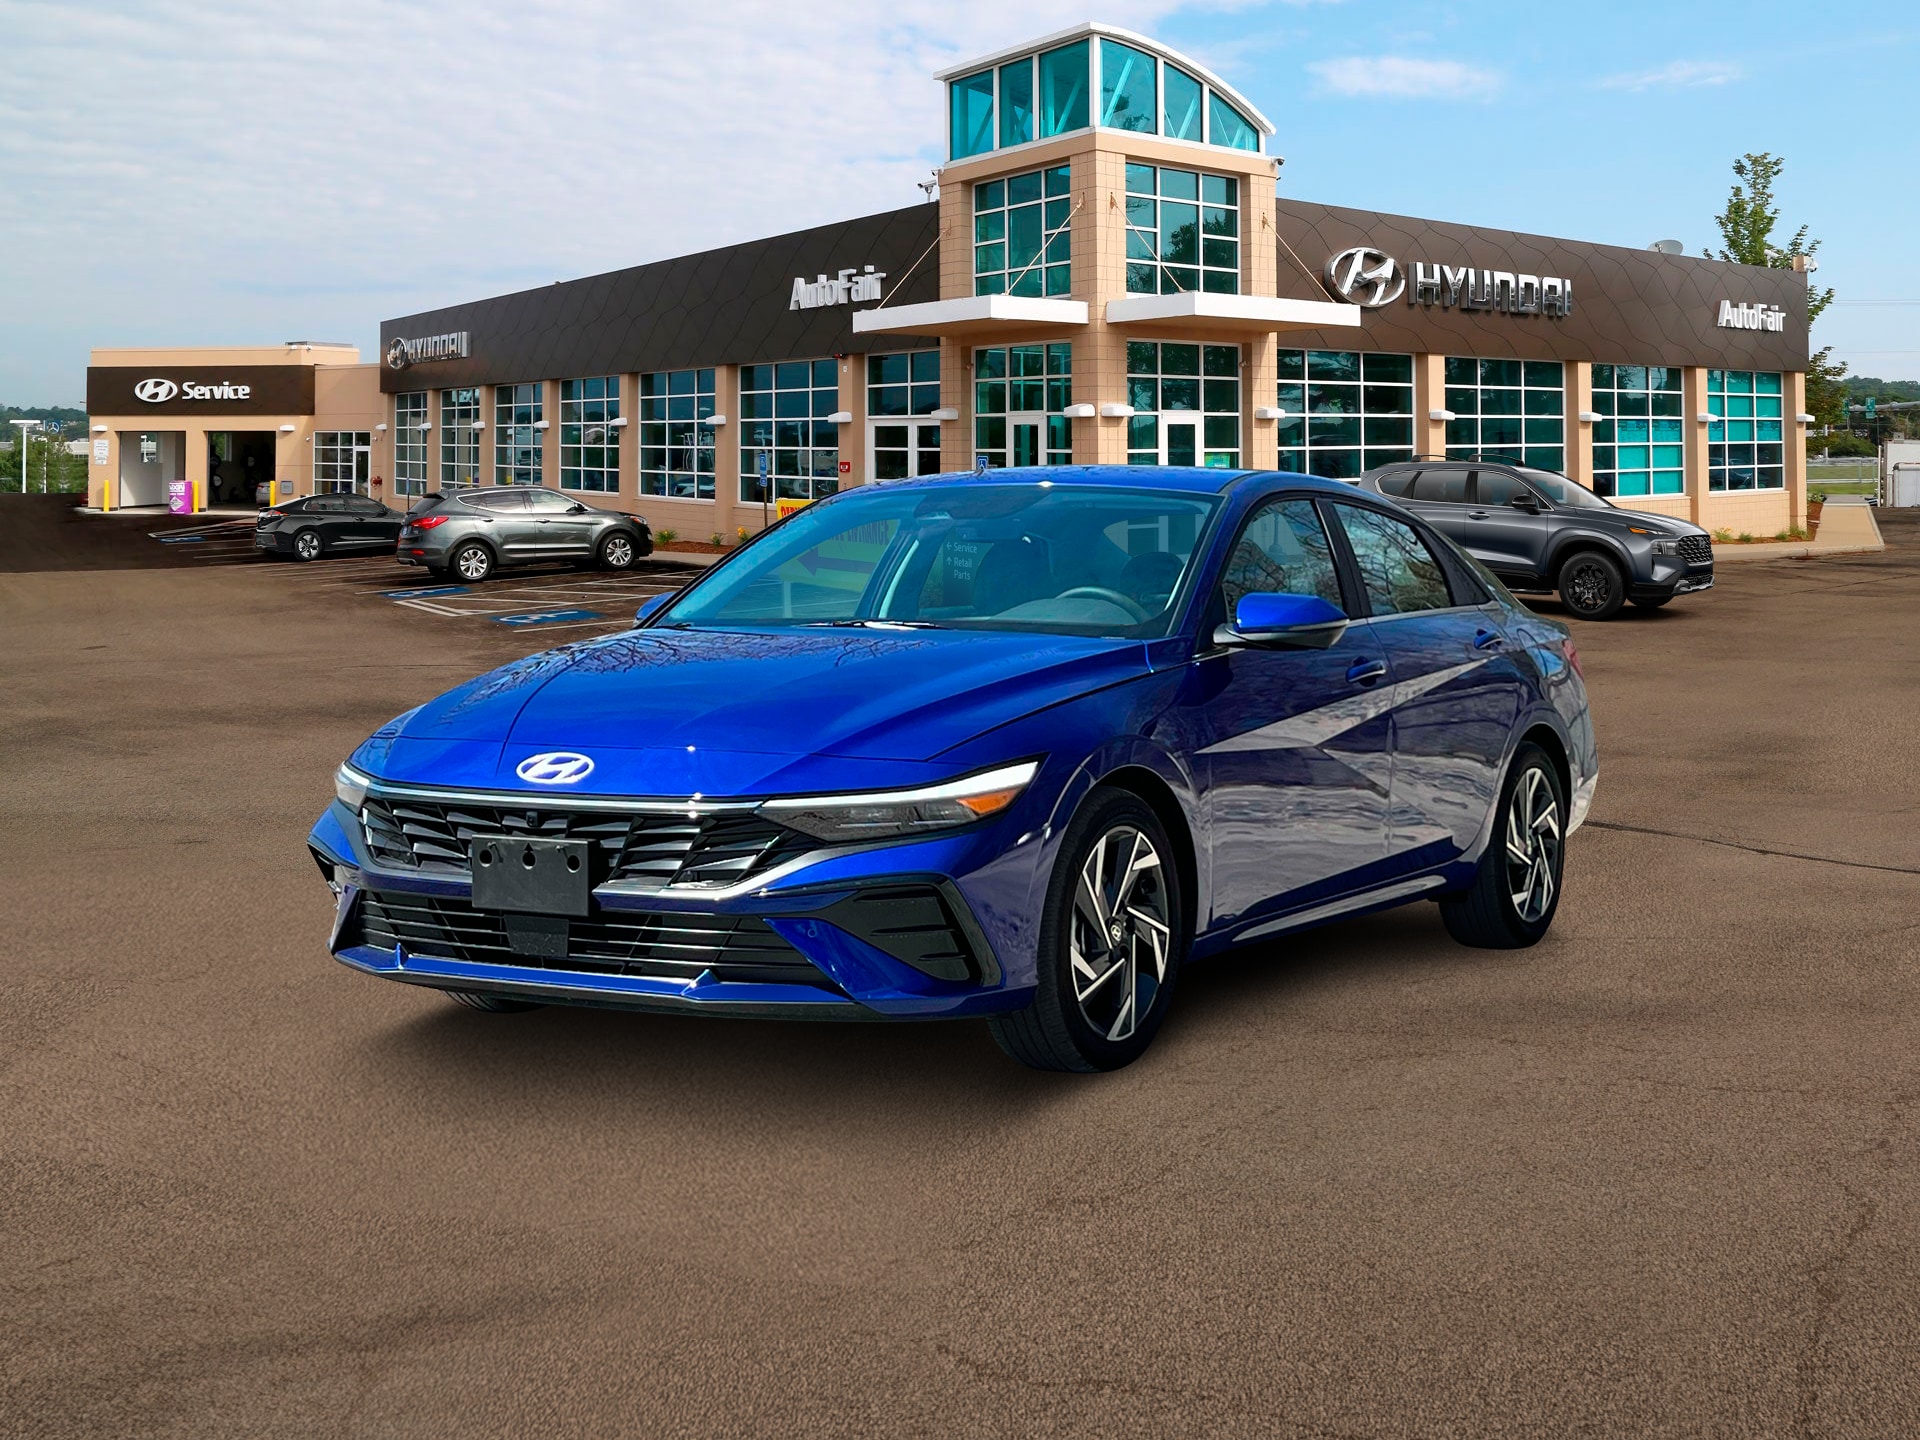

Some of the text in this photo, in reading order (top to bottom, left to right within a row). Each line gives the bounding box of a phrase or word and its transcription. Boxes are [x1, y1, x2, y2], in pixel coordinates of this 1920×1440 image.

[789, 265, 887, 310] AutoFair
[1408, 262, 1572, 317] HYUNDAI
[1717, 300, 1786, 332] AutoFair
[406, 332, 469, 363] HYUNDAI
[182, 381, 250, 400] Service
[953, 542, 978, 554] Service
[953, 557, 973, 568] Retail
[953, 569, 971, 580] Parts
